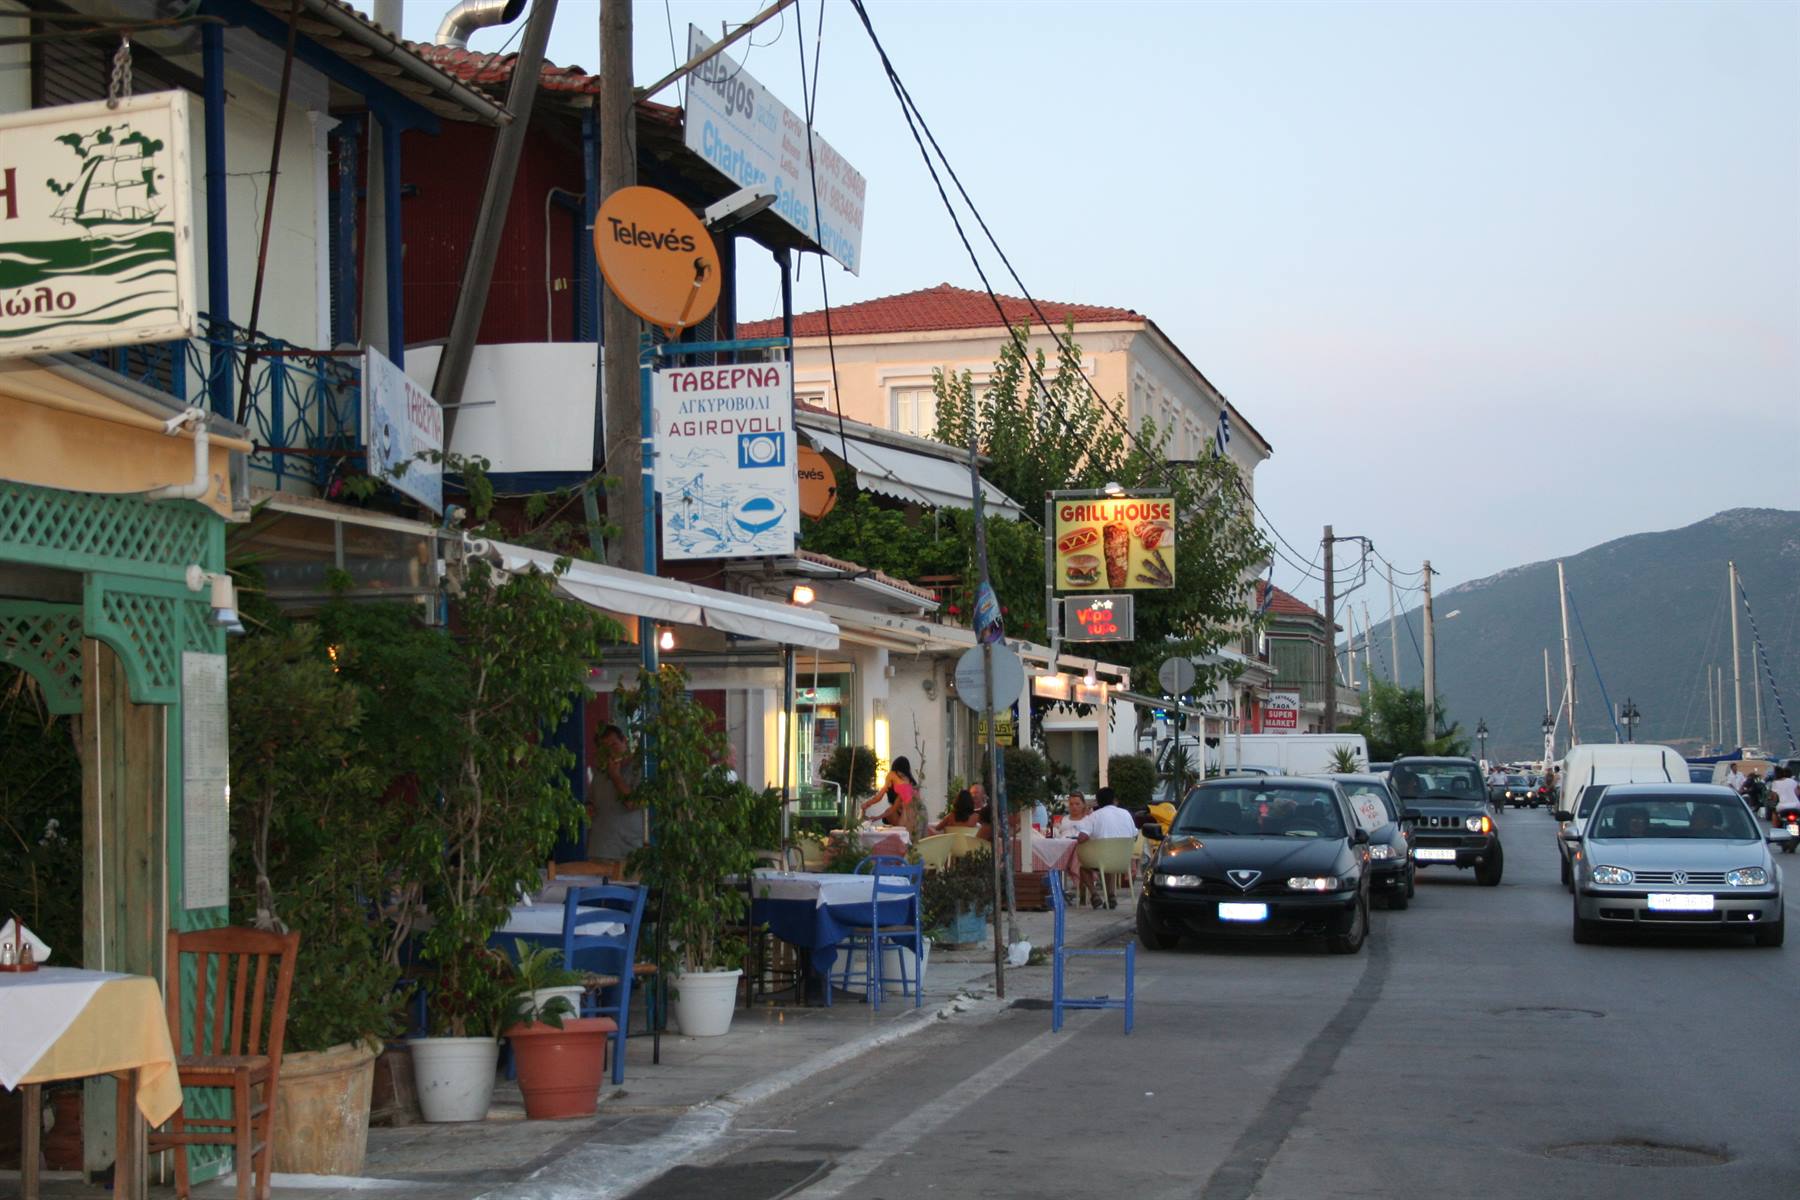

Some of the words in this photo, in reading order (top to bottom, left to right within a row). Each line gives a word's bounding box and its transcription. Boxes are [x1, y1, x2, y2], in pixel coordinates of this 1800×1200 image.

[773, 175, 809, 231] Sales
[607, 216, 696, 253] Televés
[0, 286, 77, 317] ώλο
[668, 366, 781, 393] ΤΑΒΕΡΝΑ
[678, 395, 771, 416] ΑΓΚΥΡΟΒΟΛΙ
[668, 416, 783, 438] AGIROVOLI
[798, 467, 825, 480] evés
[1060, 503, 1109, 523] GRILL
[1113, 502, 1171, 522] HOUSE
[1265, 719, 1296, 727] MARKET
[1268, 710, 1293, 719] SUPER
